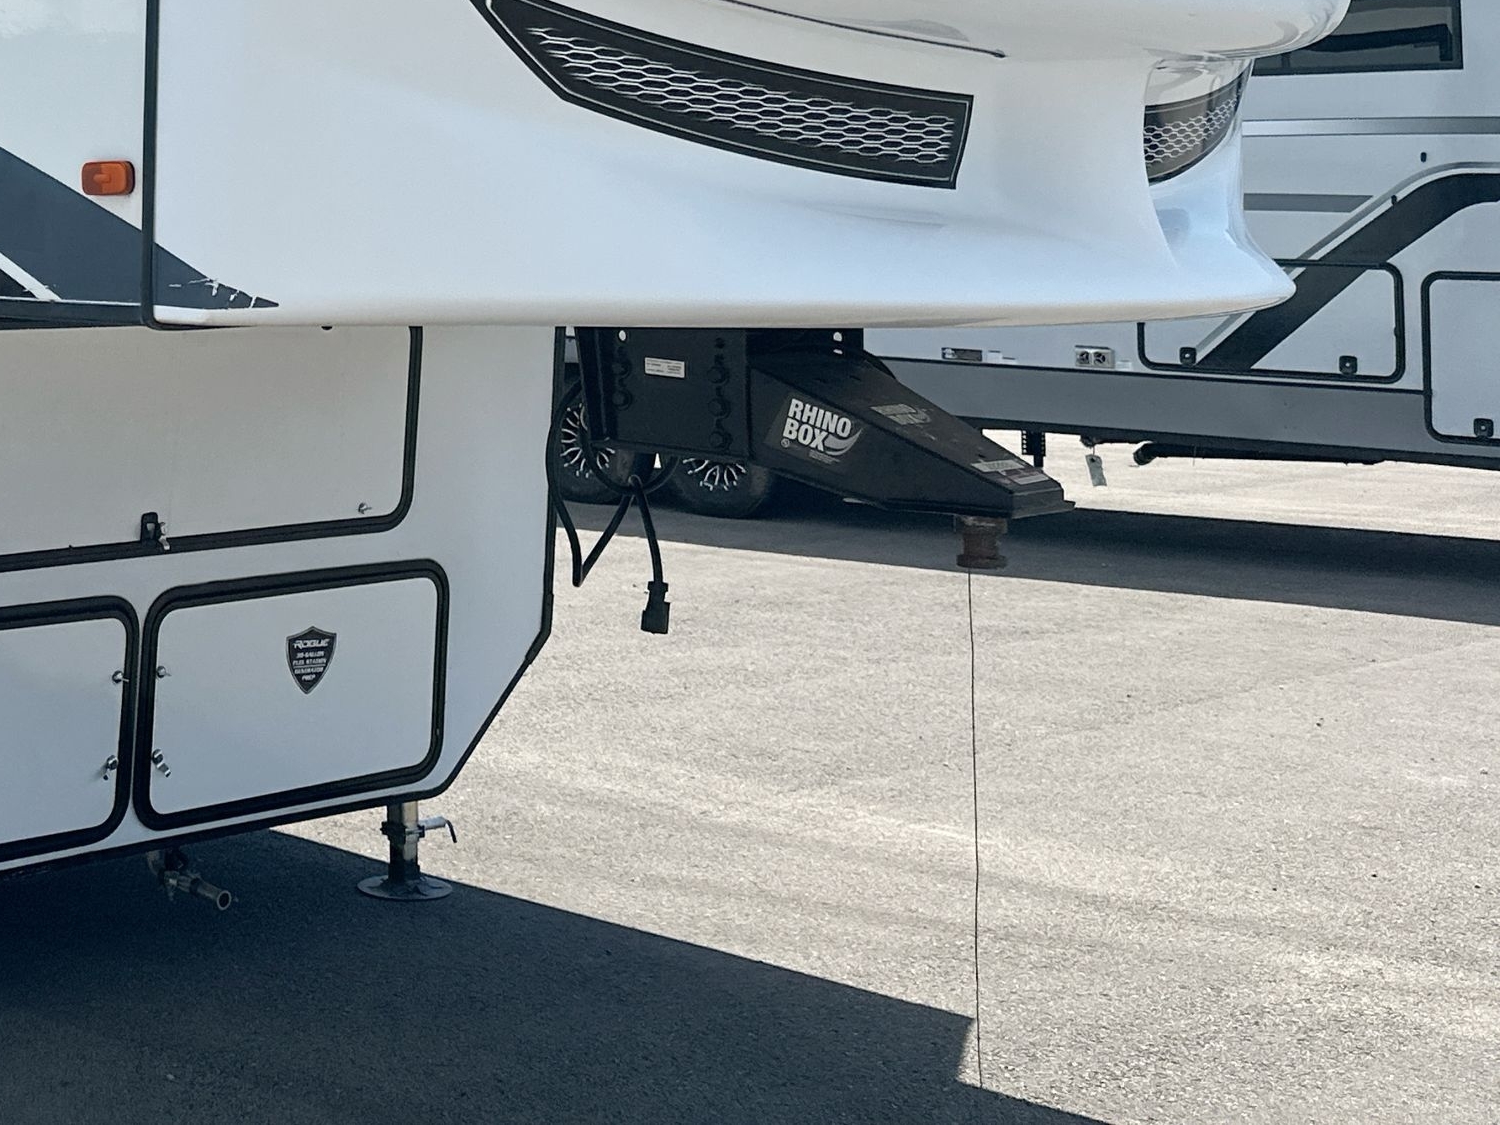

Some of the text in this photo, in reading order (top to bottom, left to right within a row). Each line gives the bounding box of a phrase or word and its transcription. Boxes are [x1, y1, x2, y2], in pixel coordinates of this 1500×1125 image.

[782, 417, 829, 452] BOX
[787, 397, 852, 439] RHINO
[293, 638, 330, 649] ROGUE
